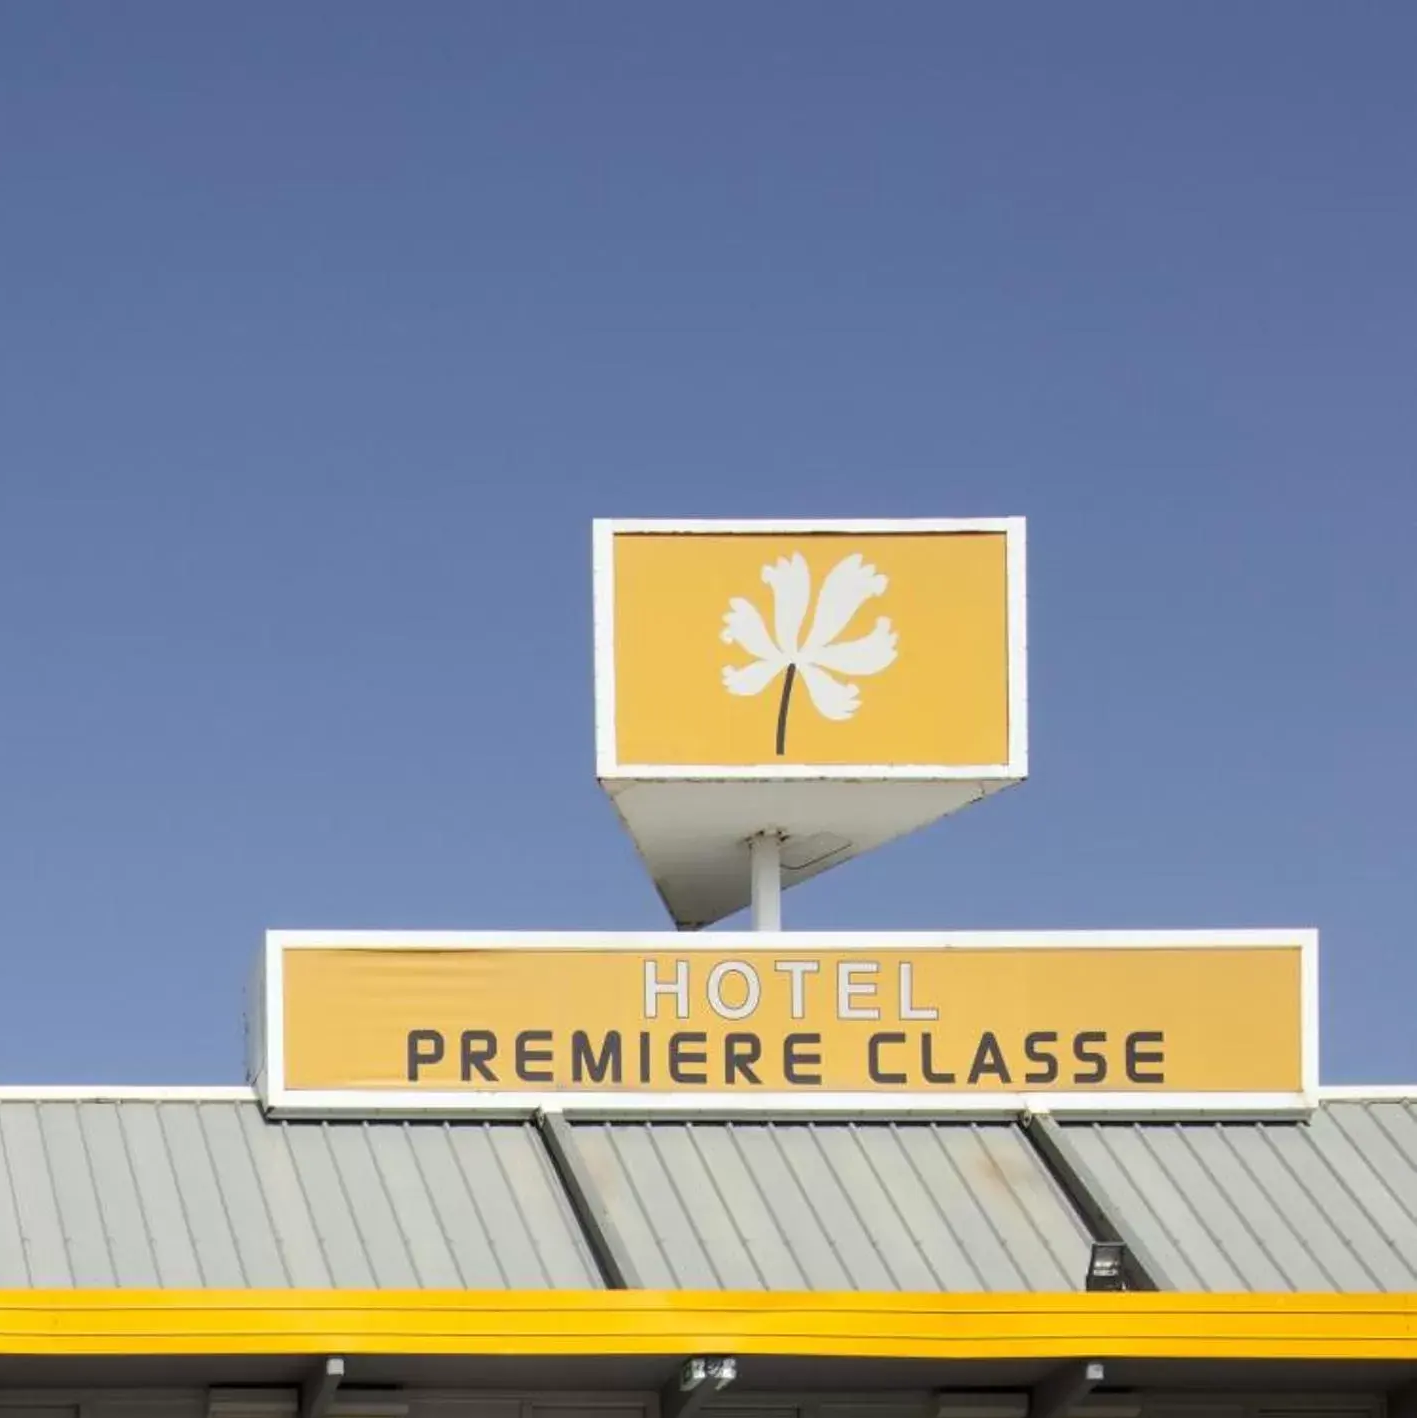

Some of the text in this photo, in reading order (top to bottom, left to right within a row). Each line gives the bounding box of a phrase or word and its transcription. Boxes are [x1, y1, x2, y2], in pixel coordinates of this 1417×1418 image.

[643, 960, 939, 1020] HOTEL
[407, 1030, 1166, 1085] PREMIERE CLASSE
